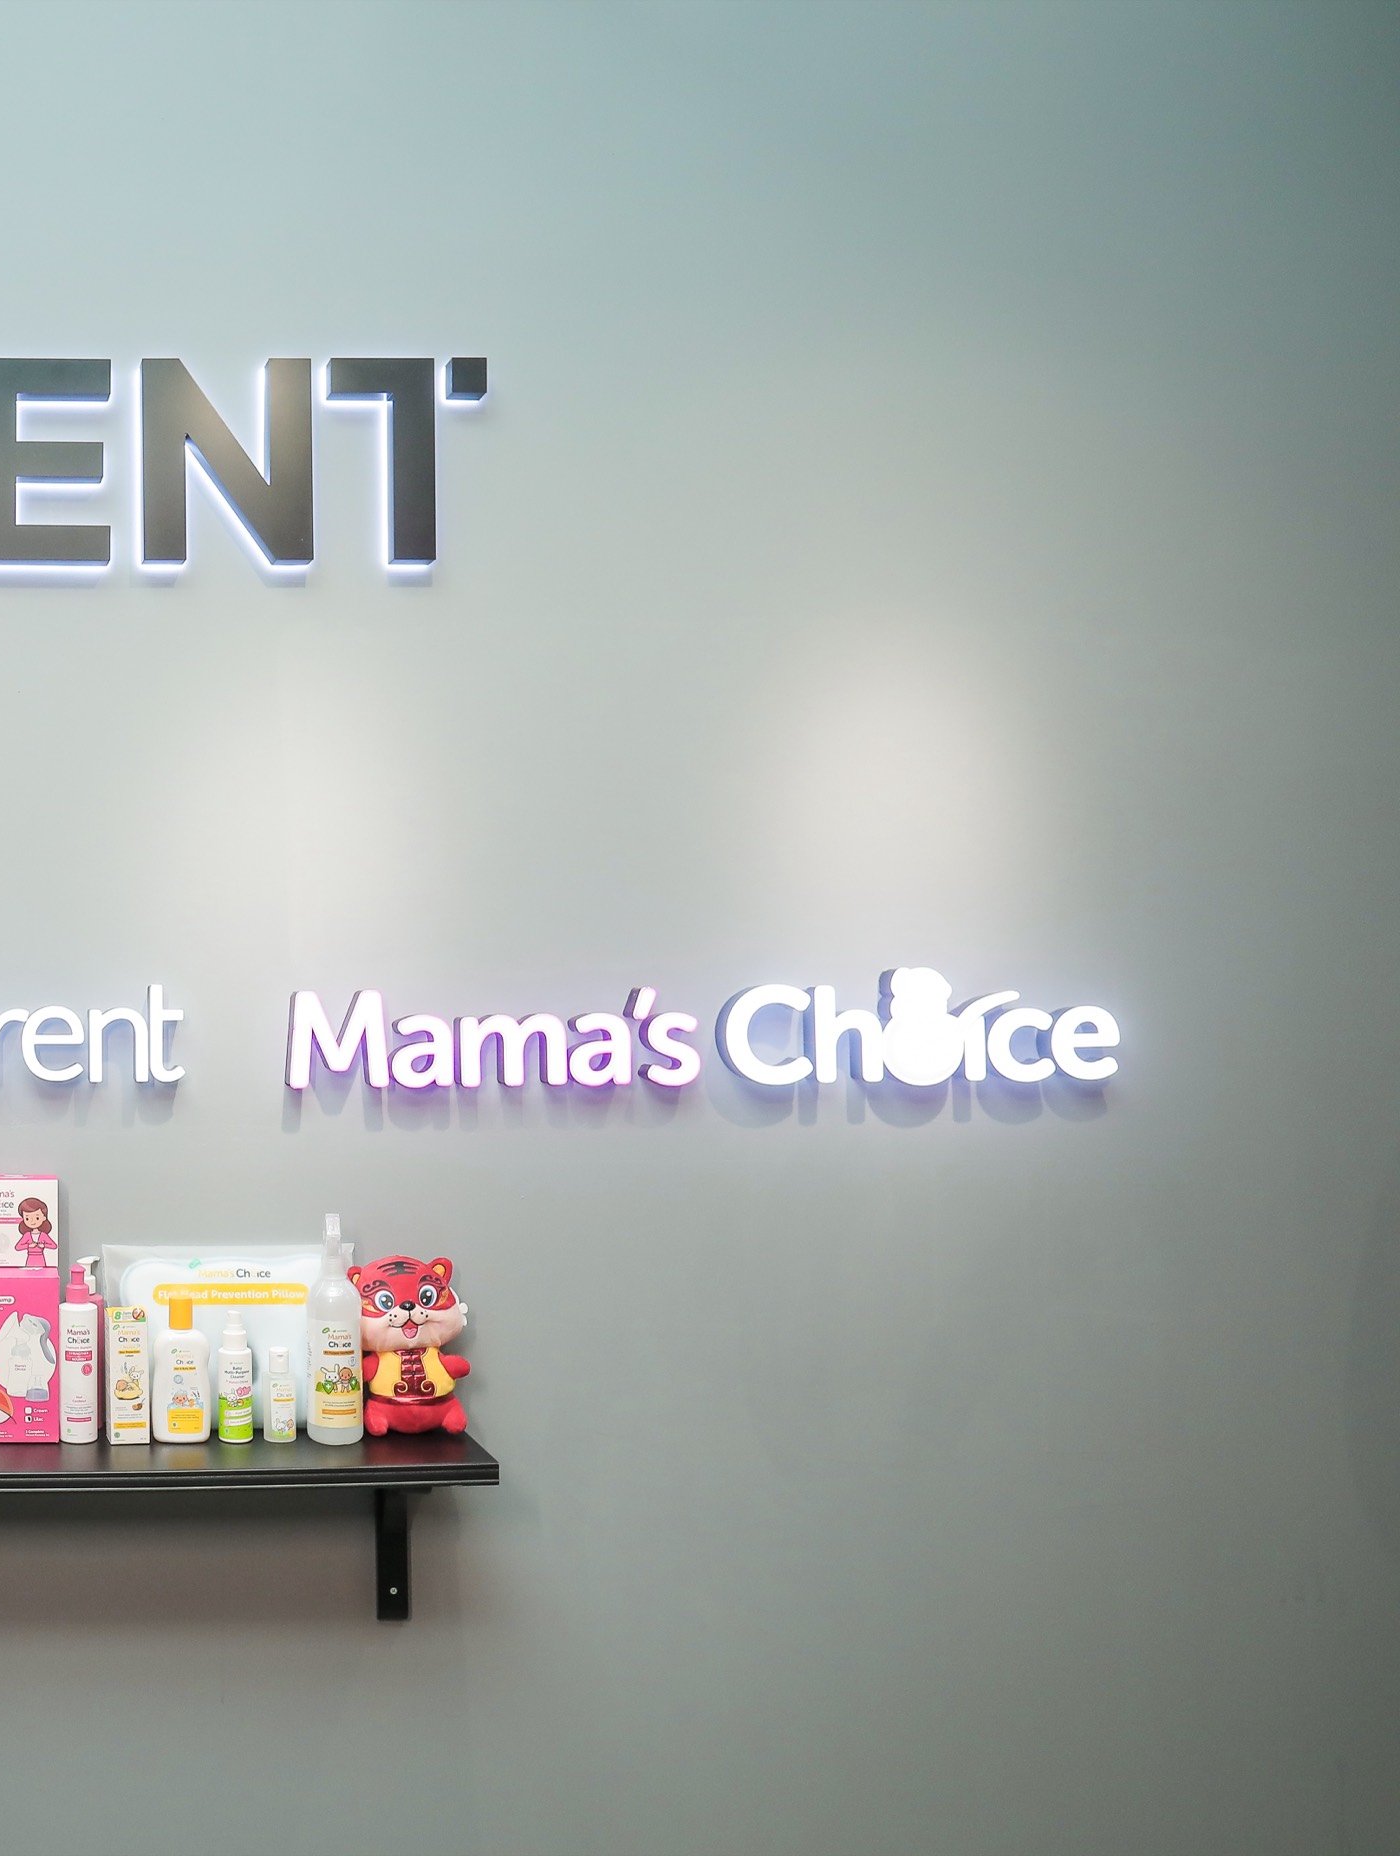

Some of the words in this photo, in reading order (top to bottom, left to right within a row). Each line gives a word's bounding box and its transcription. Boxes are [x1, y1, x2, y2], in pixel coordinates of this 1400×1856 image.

[285, 986, 702, 1090] Mama's
[198, 1269, 234, 1278] Mama's
[211, 1289, 269, 1299] Prevention
[272, 1289, 305, 1299] Pillow
[114, 1311, 122, 1320] 8
